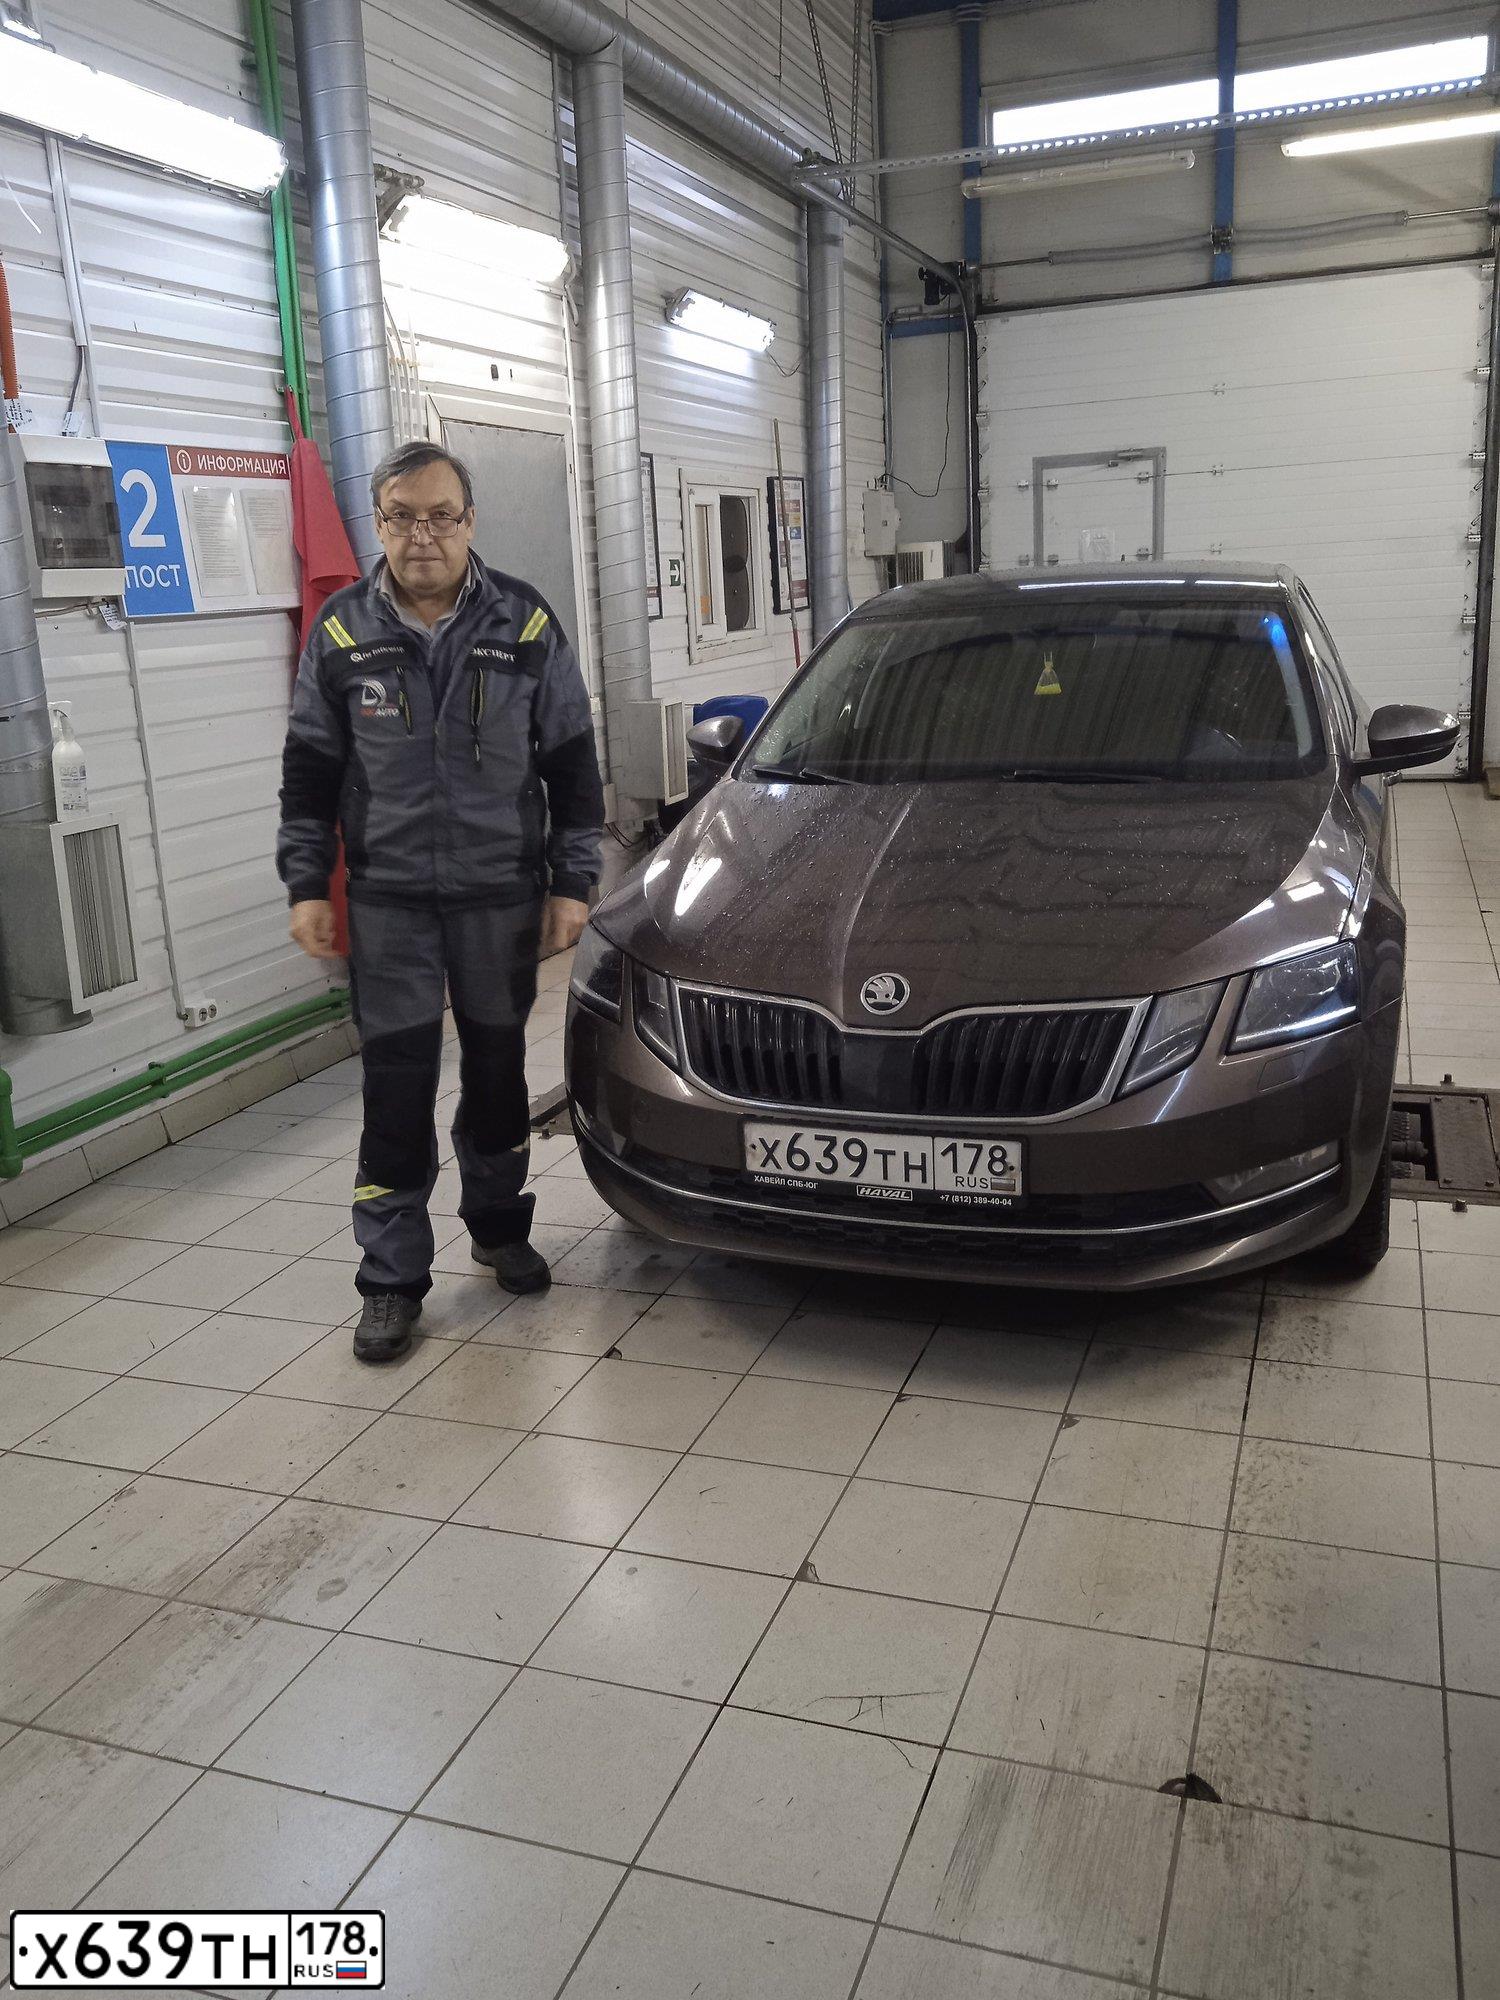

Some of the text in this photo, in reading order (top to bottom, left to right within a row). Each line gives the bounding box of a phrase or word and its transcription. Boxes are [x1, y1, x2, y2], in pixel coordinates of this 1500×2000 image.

[197, 454, 287, 476] ИНФОРМАЦИЯ
[120, 469, 166, 548] 2
[125, 564, 180, 589] ПОСТ
[758, 1132, 1007, 1184] Х639ТН 178
[754, 1174, 786, 1186] ХАВЕЙЛ
[955, 1175, 989, 1189] RUS
[859, 1186, 911, 1199] HAVAL
[940, 1194, 1012, 1206] +7 (812) 389-40-04
